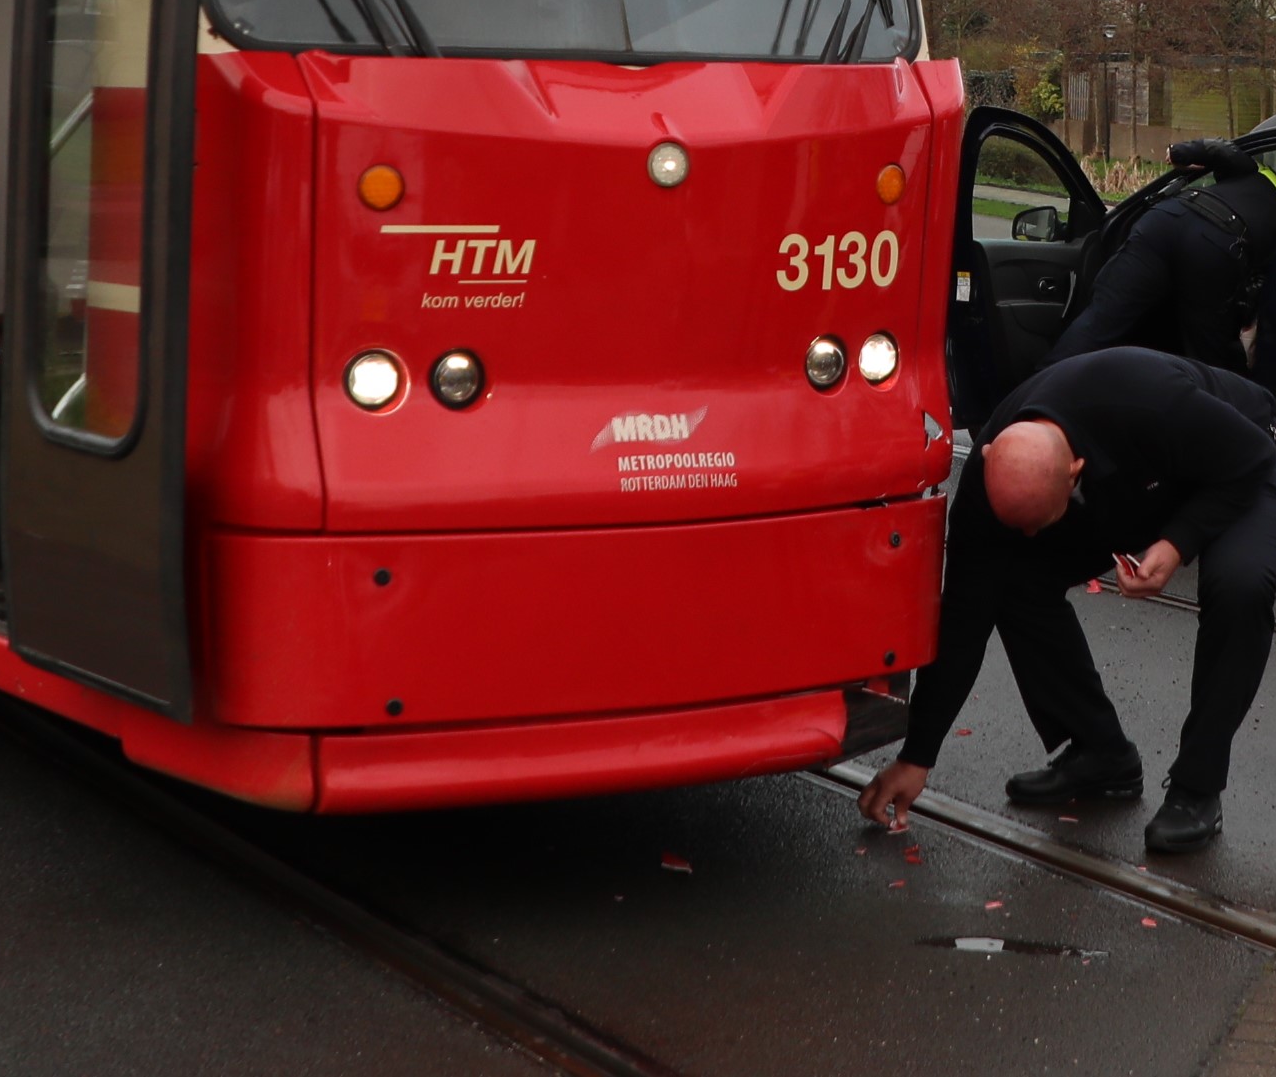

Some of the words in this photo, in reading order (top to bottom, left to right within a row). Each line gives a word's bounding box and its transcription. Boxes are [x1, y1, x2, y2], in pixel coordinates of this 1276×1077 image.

[429, 239, 537, 275] HTM
[776, 229, 899, 292] 3130
[421, 292, 459, 309] kom
[463, 291, 526, 309] verder!
[611, 413, 690, 443] MRDH
[617, 451, 736, 473] METROPOOLREGIO
[620, 473, 686, 493] ROTTERDAM
[688, 473, 709, 489] DEN
[710, 472, 738, 489] HAAG
